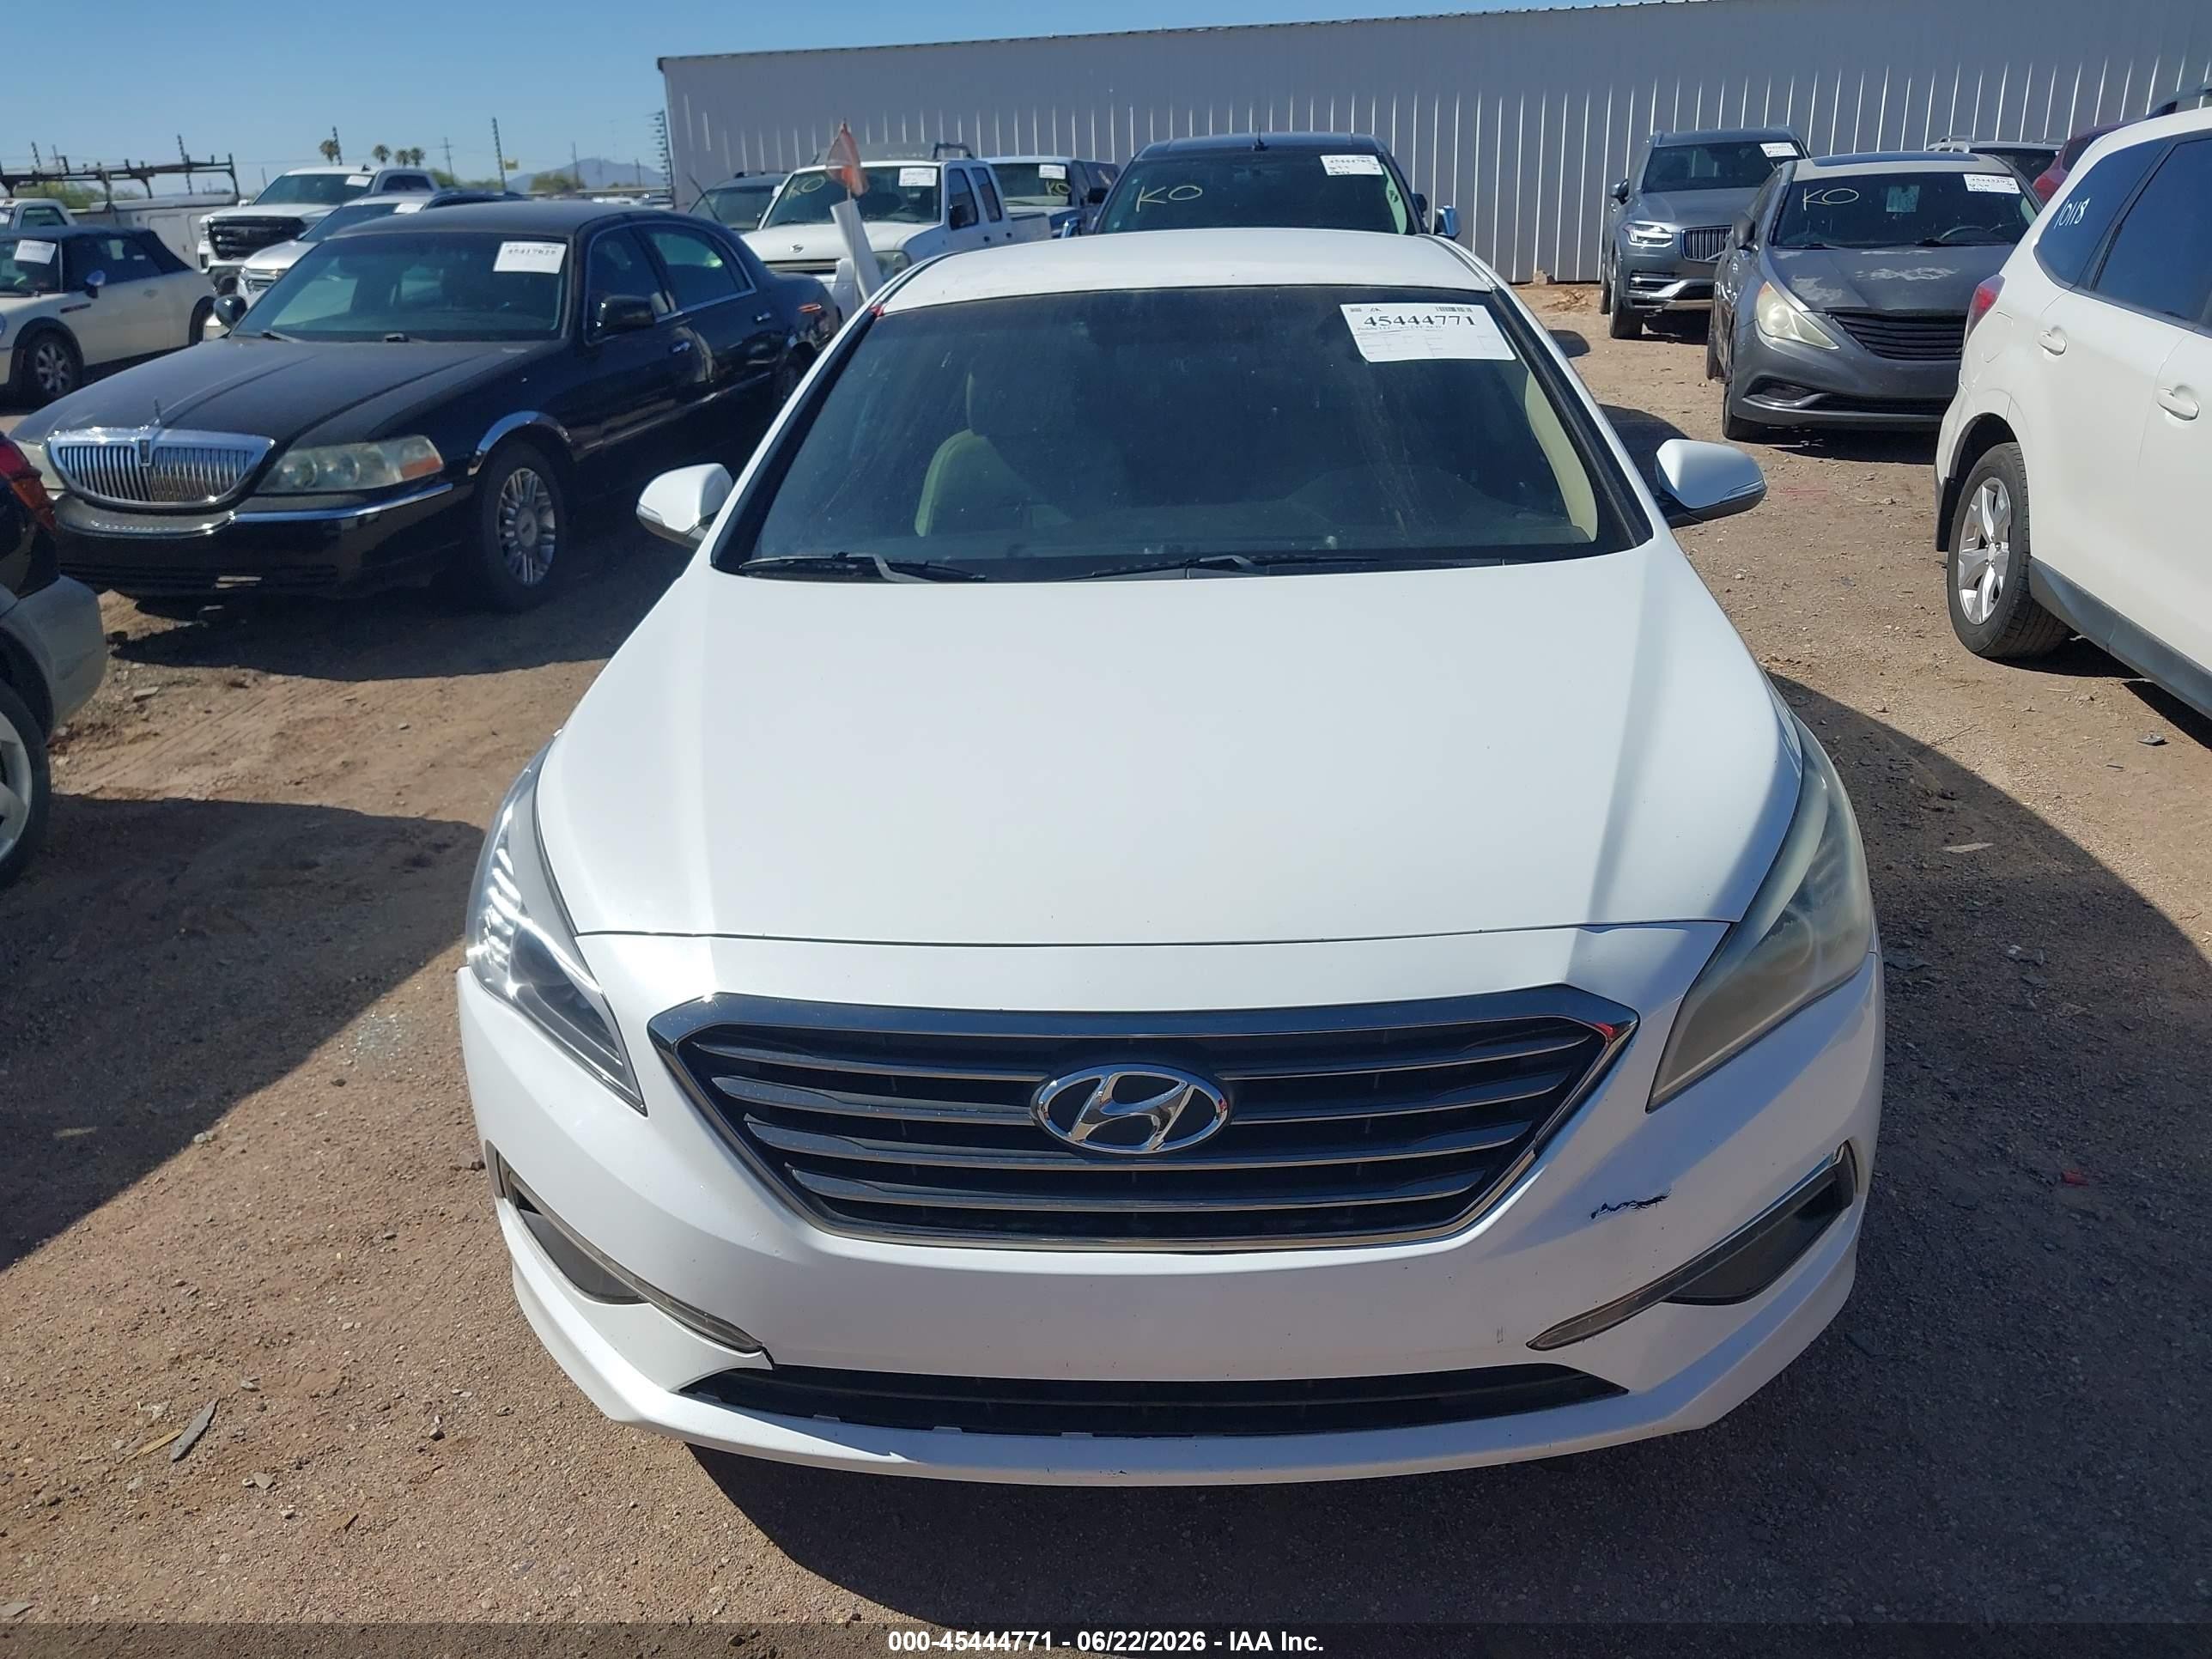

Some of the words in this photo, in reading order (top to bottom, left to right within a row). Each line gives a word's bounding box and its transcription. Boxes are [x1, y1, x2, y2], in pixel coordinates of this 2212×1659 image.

[1135, 185, 1203, 212] KO
[1802, 187, 1860, 211] KO
[1364, 315, 1477, 327] 45444771
